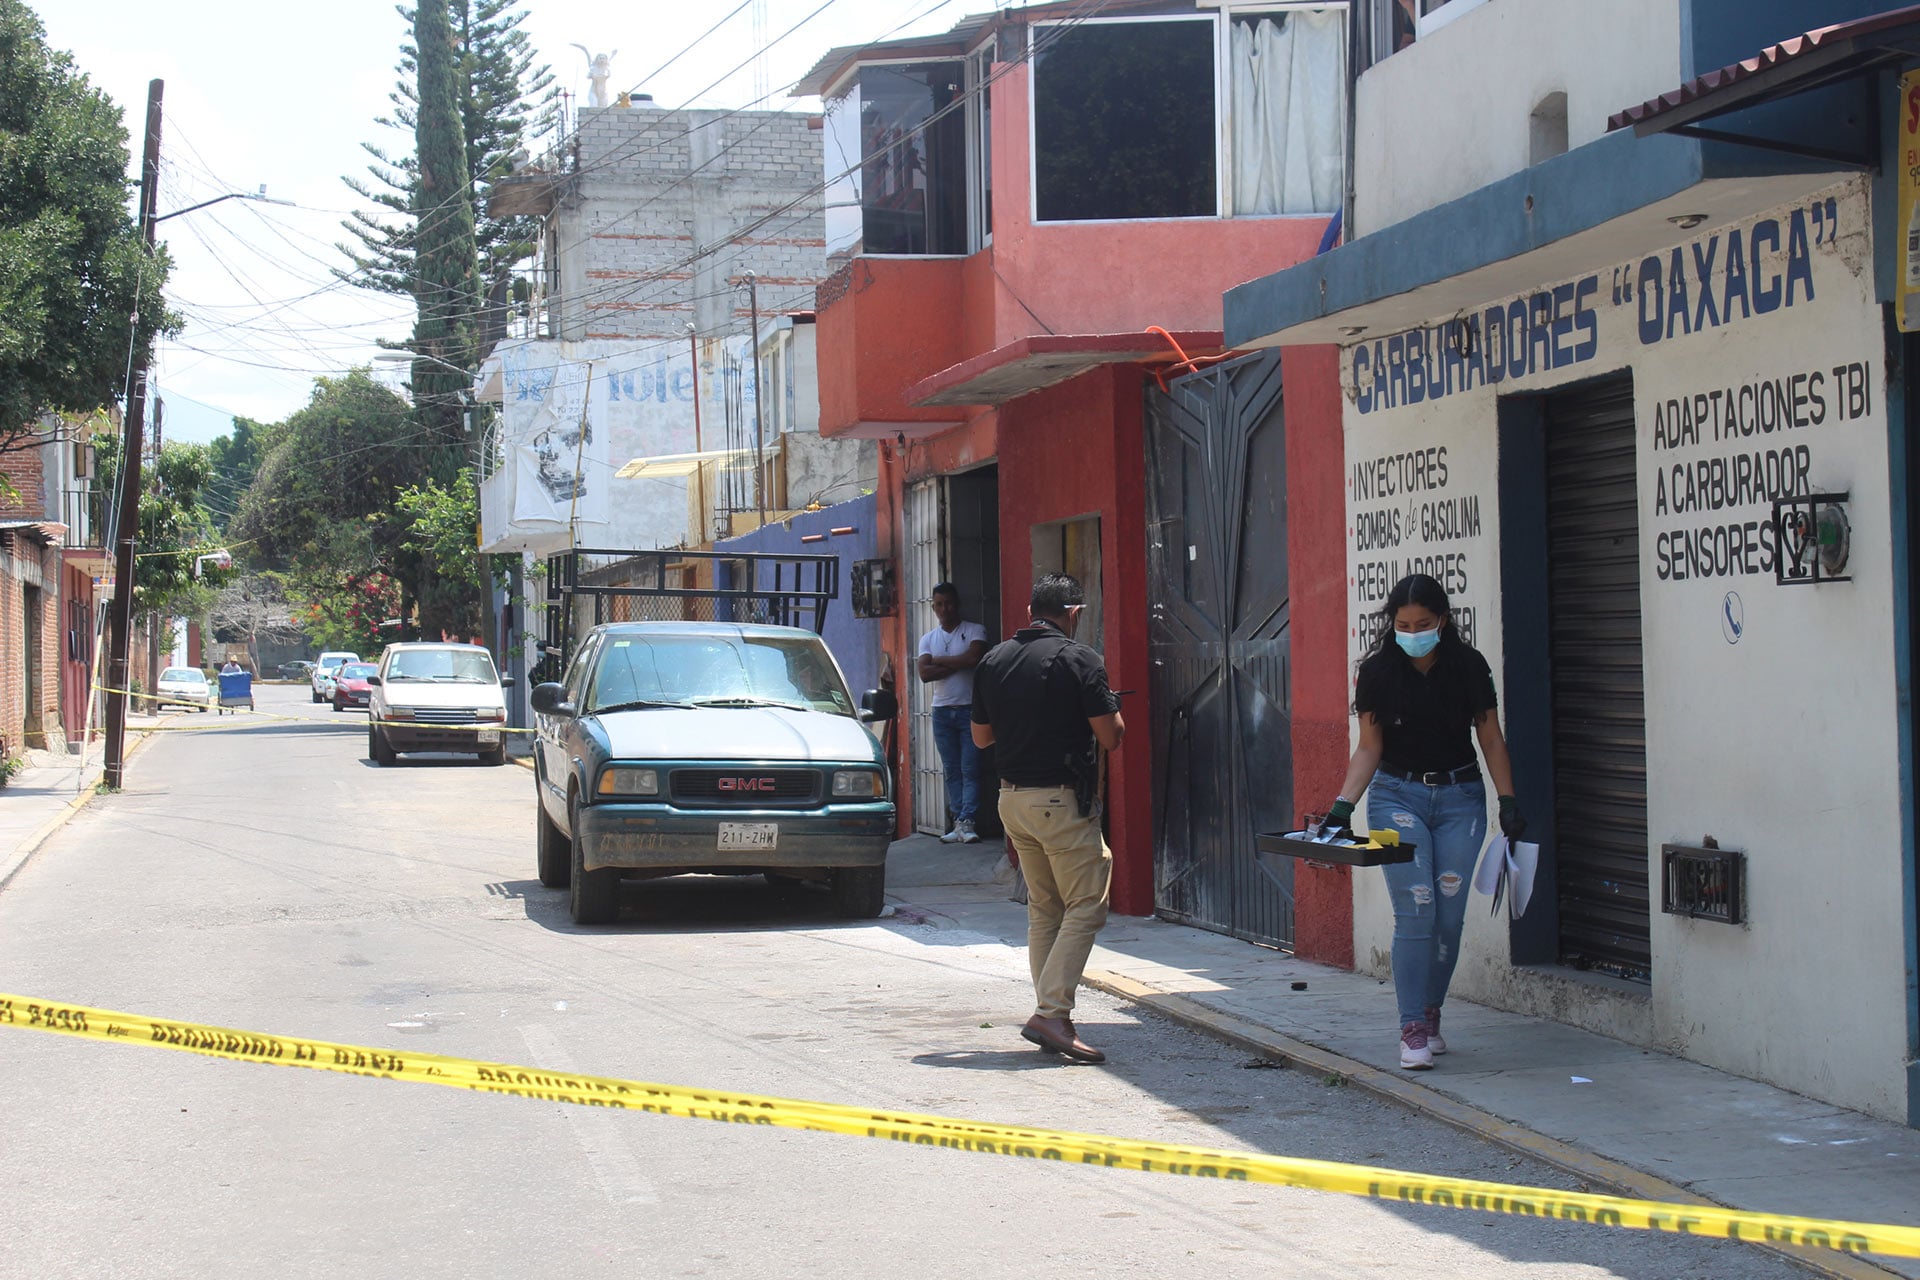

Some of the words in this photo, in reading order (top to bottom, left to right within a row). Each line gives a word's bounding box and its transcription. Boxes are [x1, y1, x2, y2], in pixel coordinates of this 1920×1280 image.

[1353, 276, 1598, 415] CARBURADORES
[1654, 371, 1826, 450] ADAPTACIONES
[1832, 361, 1871, 421] TBI
[1353, 446, 1448, 502] INYECTORES
[1656, 467, 1668, 517] A
[1671, 445, 1810, 514] CARBURADOR
[1356, 508, 1400, 552] BOMBAS
[1421, 495, 1481, 543] GASOLINA
[1656, 520, 1776, 581] SENSORES
[718, 777, 776, 791] GMC
